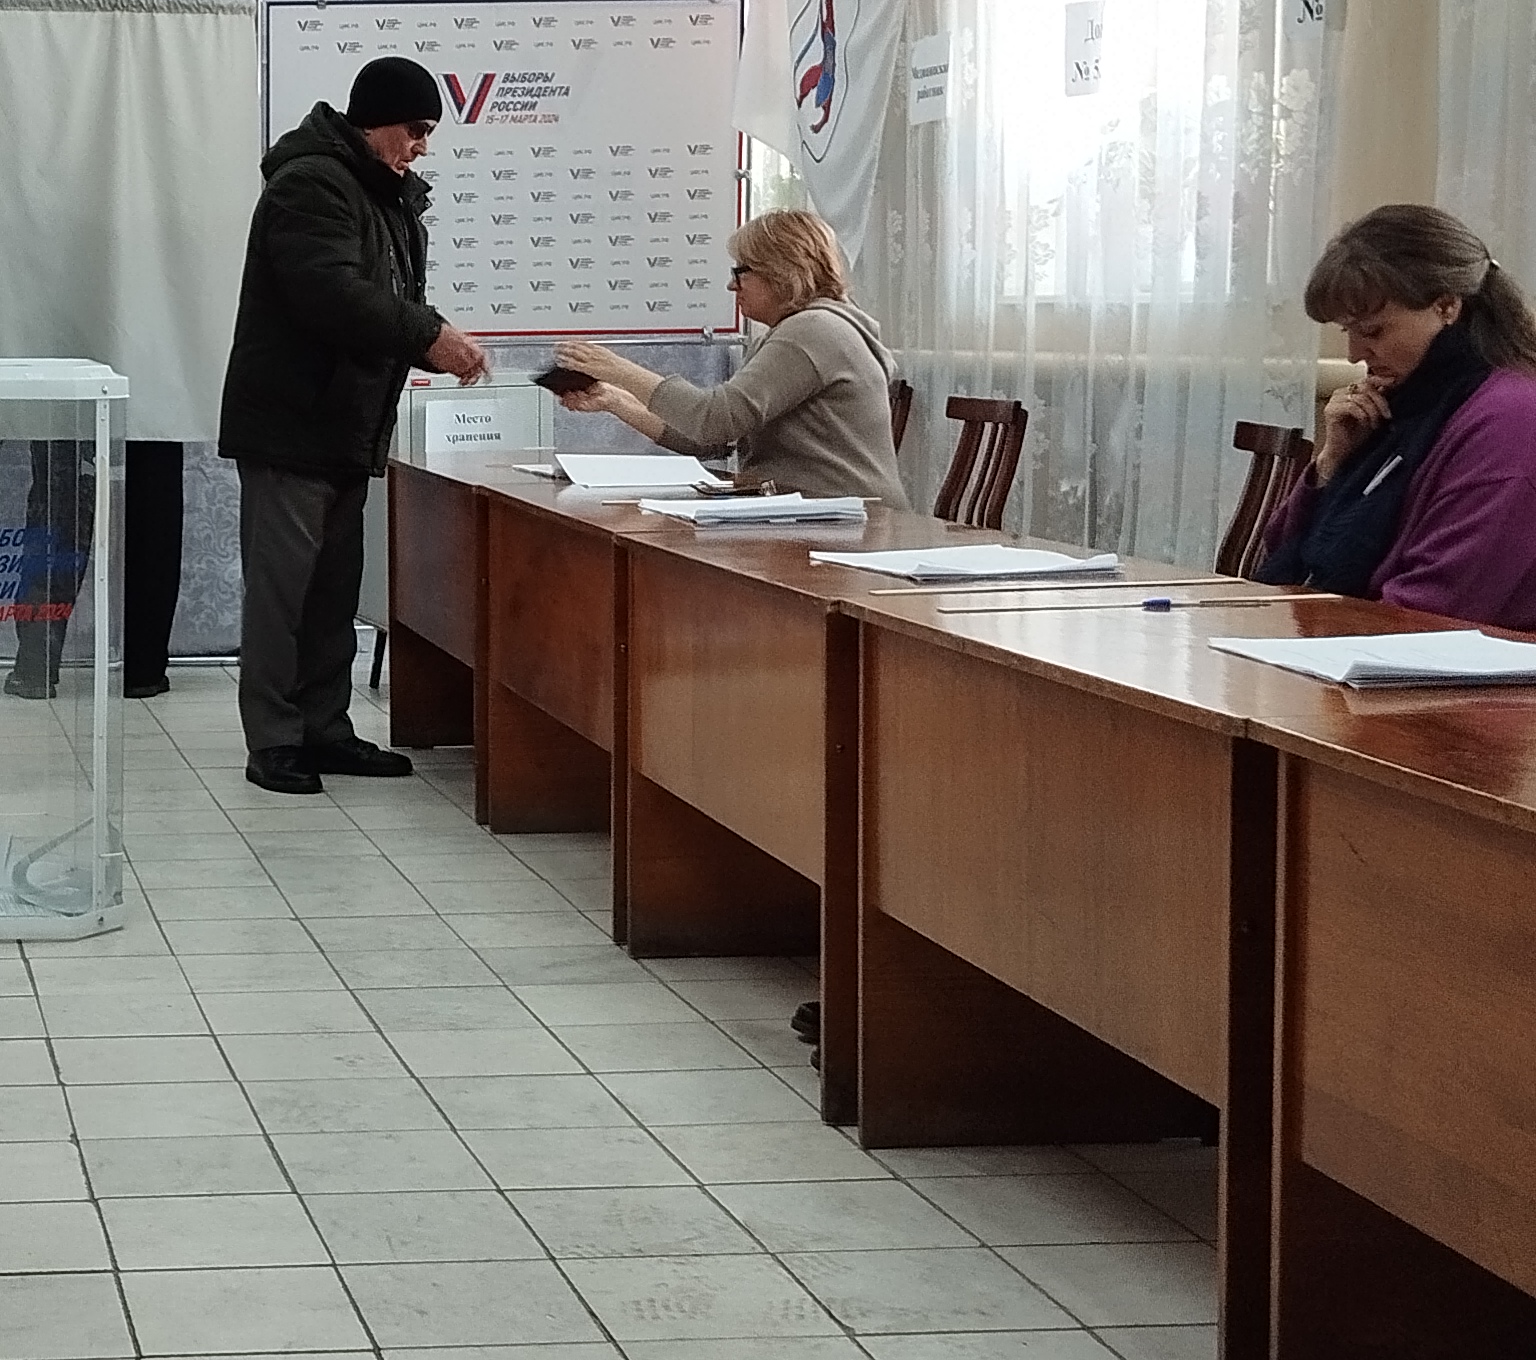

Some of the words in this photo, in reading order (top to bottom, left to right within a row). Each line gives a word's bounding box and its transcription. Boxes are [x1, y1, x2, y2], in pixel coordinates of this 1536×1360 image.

[501, 72, 556, 84] ВЫБОРЫ
[495, 85, 571, 99] ПРЕЗИДЕНТА
[489, 101, 539, 113] РОССИИ
[509, 114, 538, 124] МАРТА
[454, 413, 492, 425] Место
[445, 431, 502, 444] хранения
